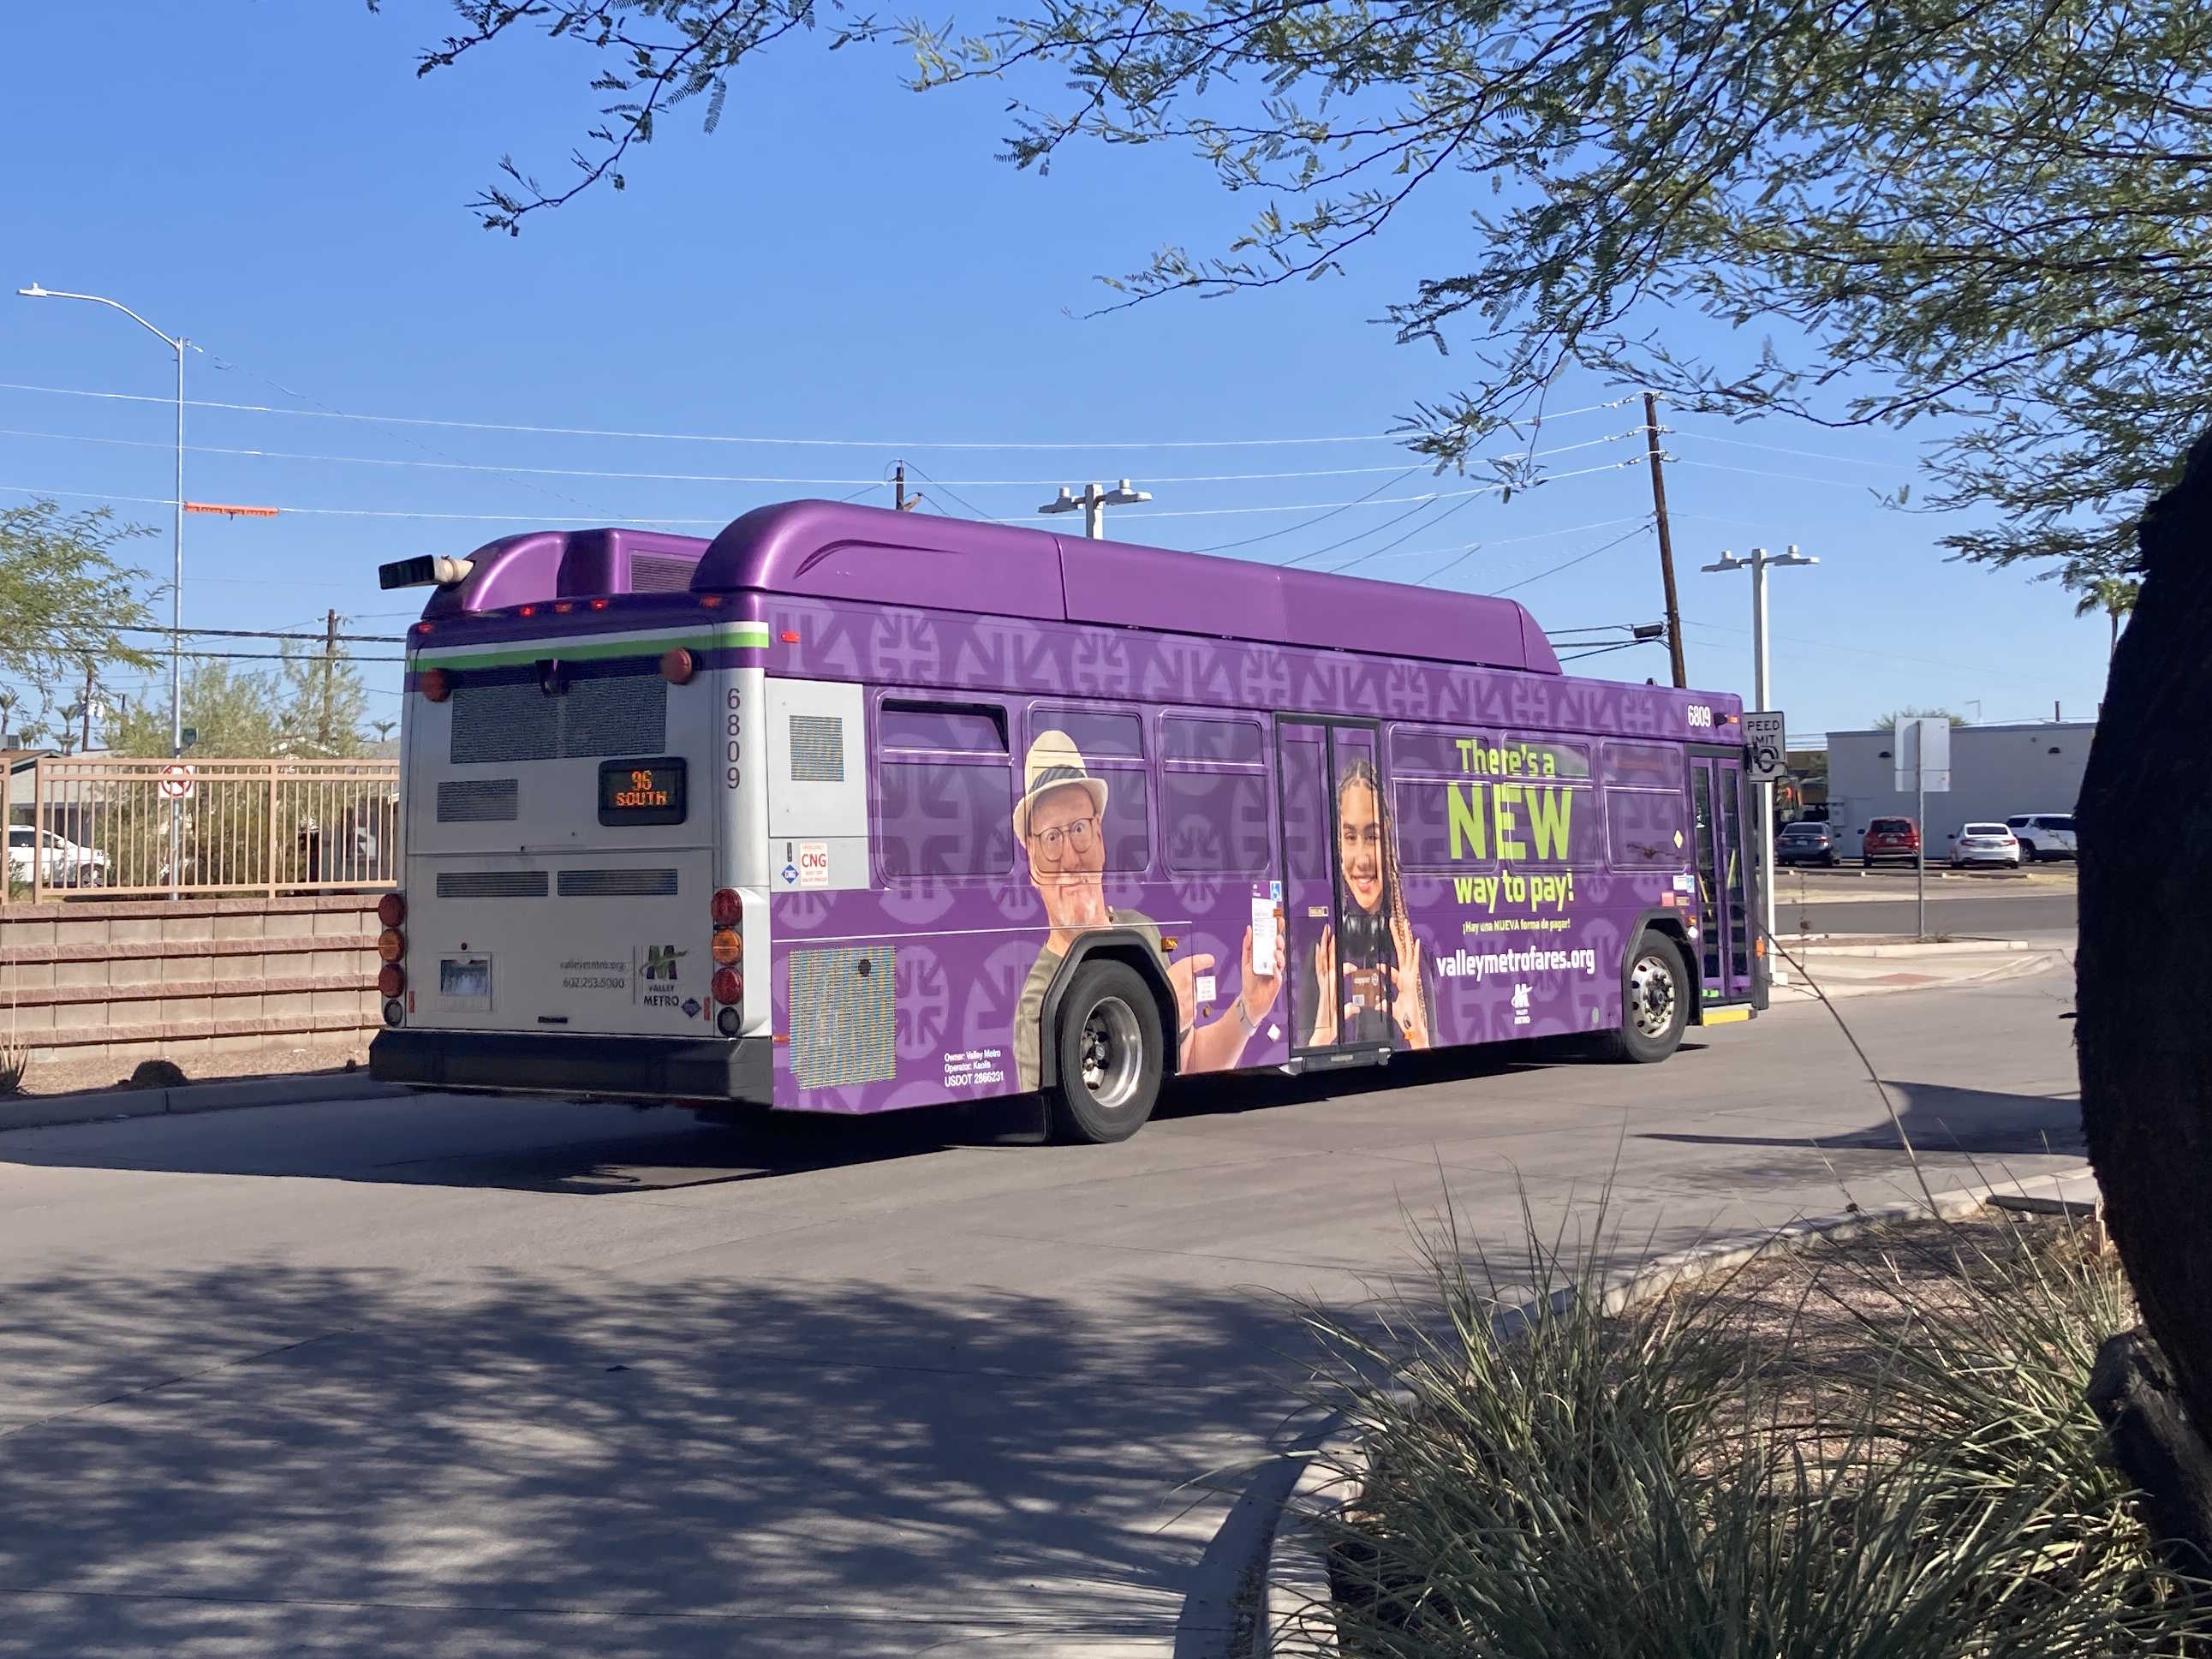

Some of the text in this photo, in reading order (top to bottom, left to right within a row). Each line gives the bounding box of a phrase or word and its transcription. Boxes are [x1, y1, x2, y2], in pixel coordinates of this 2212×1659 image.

[1687, 705, 1711, 727] 6809
[1748, 720, 1780, 731] PEED
[727, 688, 741, 790] 6809
[1752, 735, 1775, 745] IMIT
[1456, 737, 1556, 779] There's a
[630, 770, 653, 791] 96
[616, 791, 667, 807] SOUTH
[1447, 781, 1573, 861] NEW
[802, 853, 826, 868] CNG
[1453, 868, 1575, 914] way to pay!
[1494, 919, 1519, 931] NUEVA
[1436, 945, 1595, 982] valleymetrofares.org
[644, 996, 679, 1006] METRO
[966, 1050, 983, 1060] Valley
[984, 1049, 1001, 1059] Metro
[945, 1074, 972, 1087] USDOT
